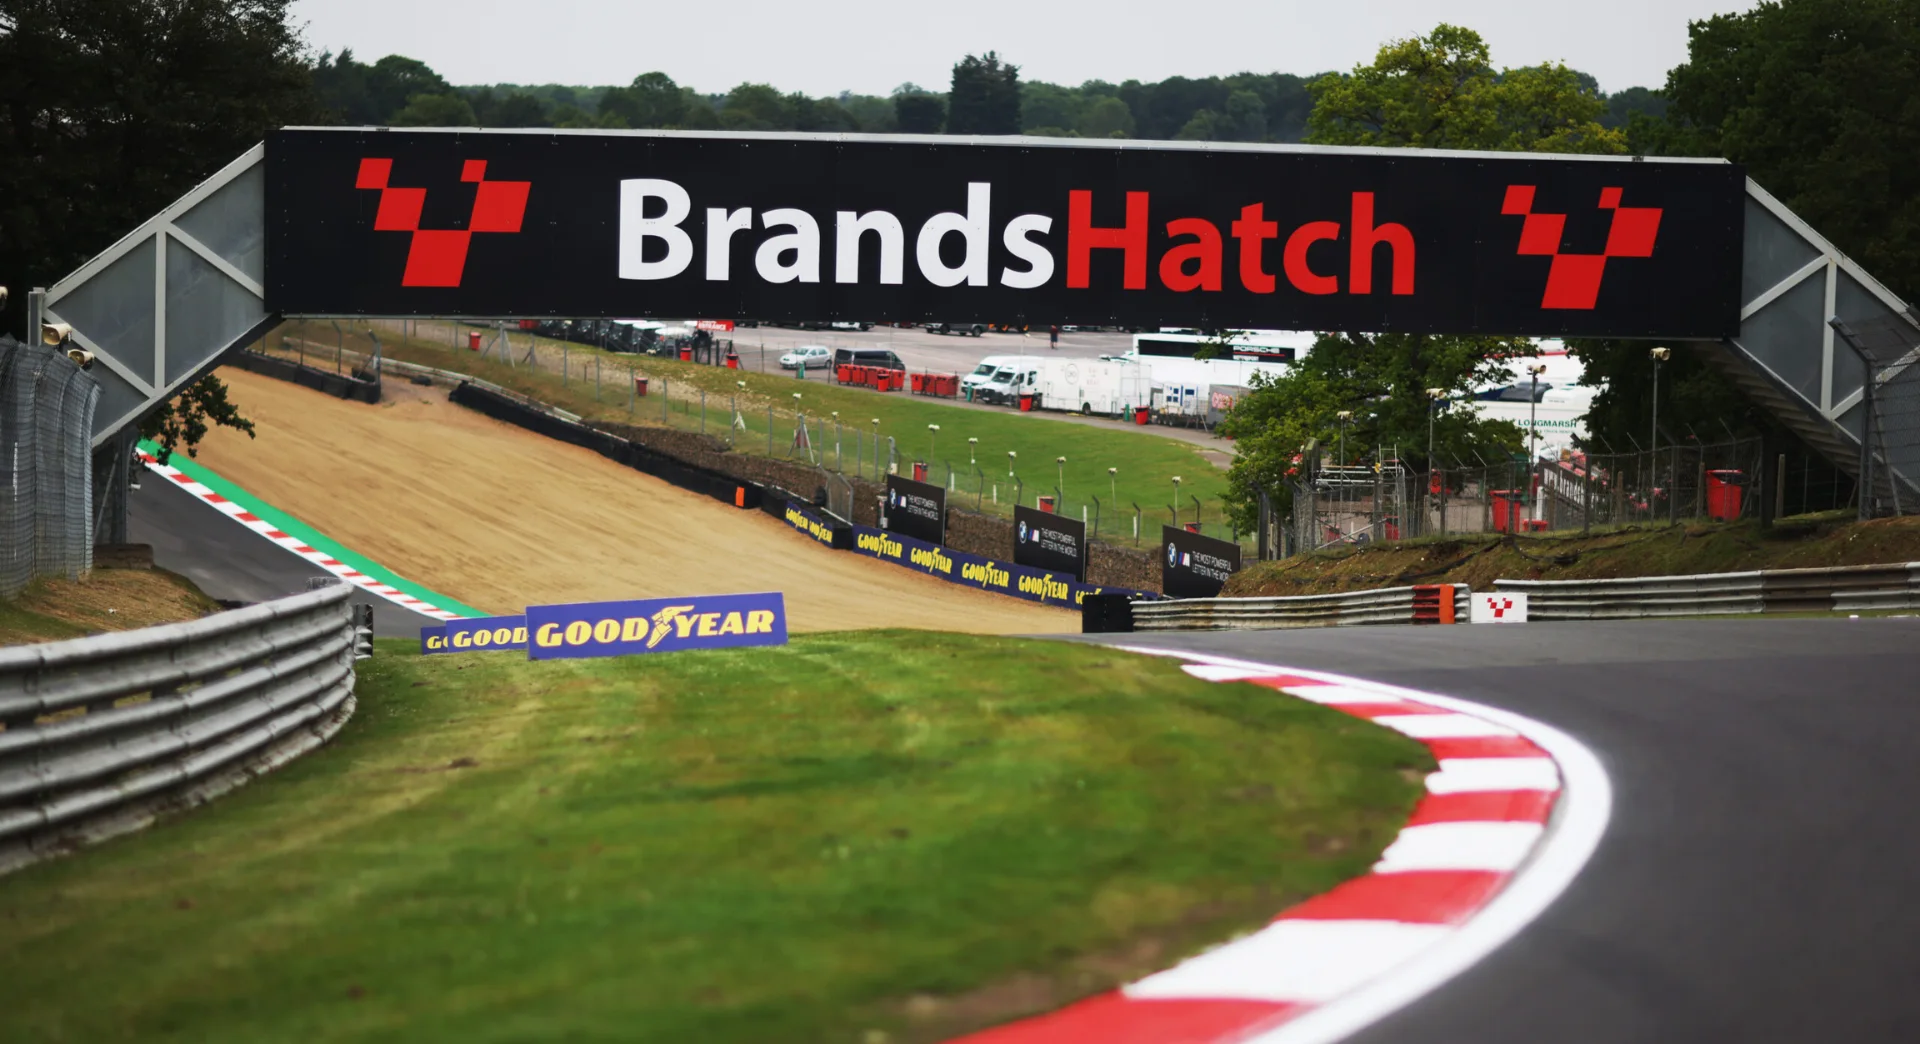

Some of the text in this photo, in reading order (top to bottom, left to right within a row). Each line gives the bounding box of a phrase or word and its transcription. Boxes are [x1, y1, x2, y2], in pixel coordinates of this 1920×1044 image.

[1192, 550, 1232, 572] THE MOST POWERFUL
